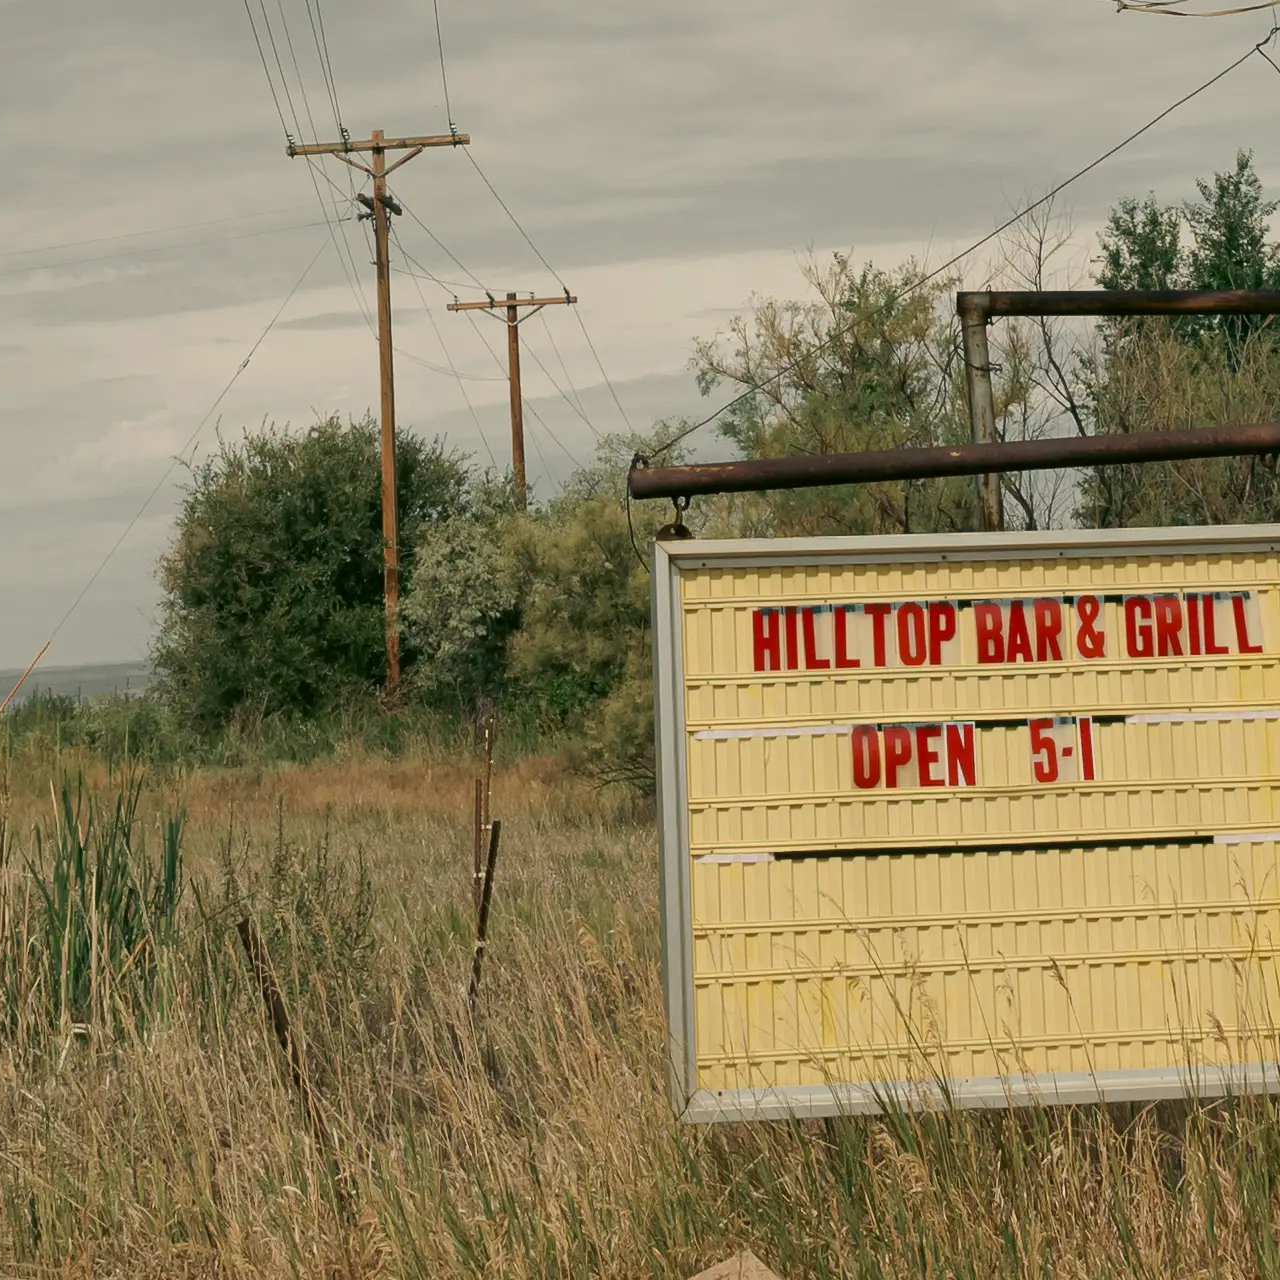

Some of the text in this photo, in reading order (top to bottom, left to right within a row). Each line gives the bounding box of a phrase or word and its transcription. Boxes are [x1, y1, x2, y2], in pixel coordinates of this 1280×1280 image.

[752, 594, 1263, 671] HILLTOP BAR & GRILL
[851, 724, 977, 789] OPEN
